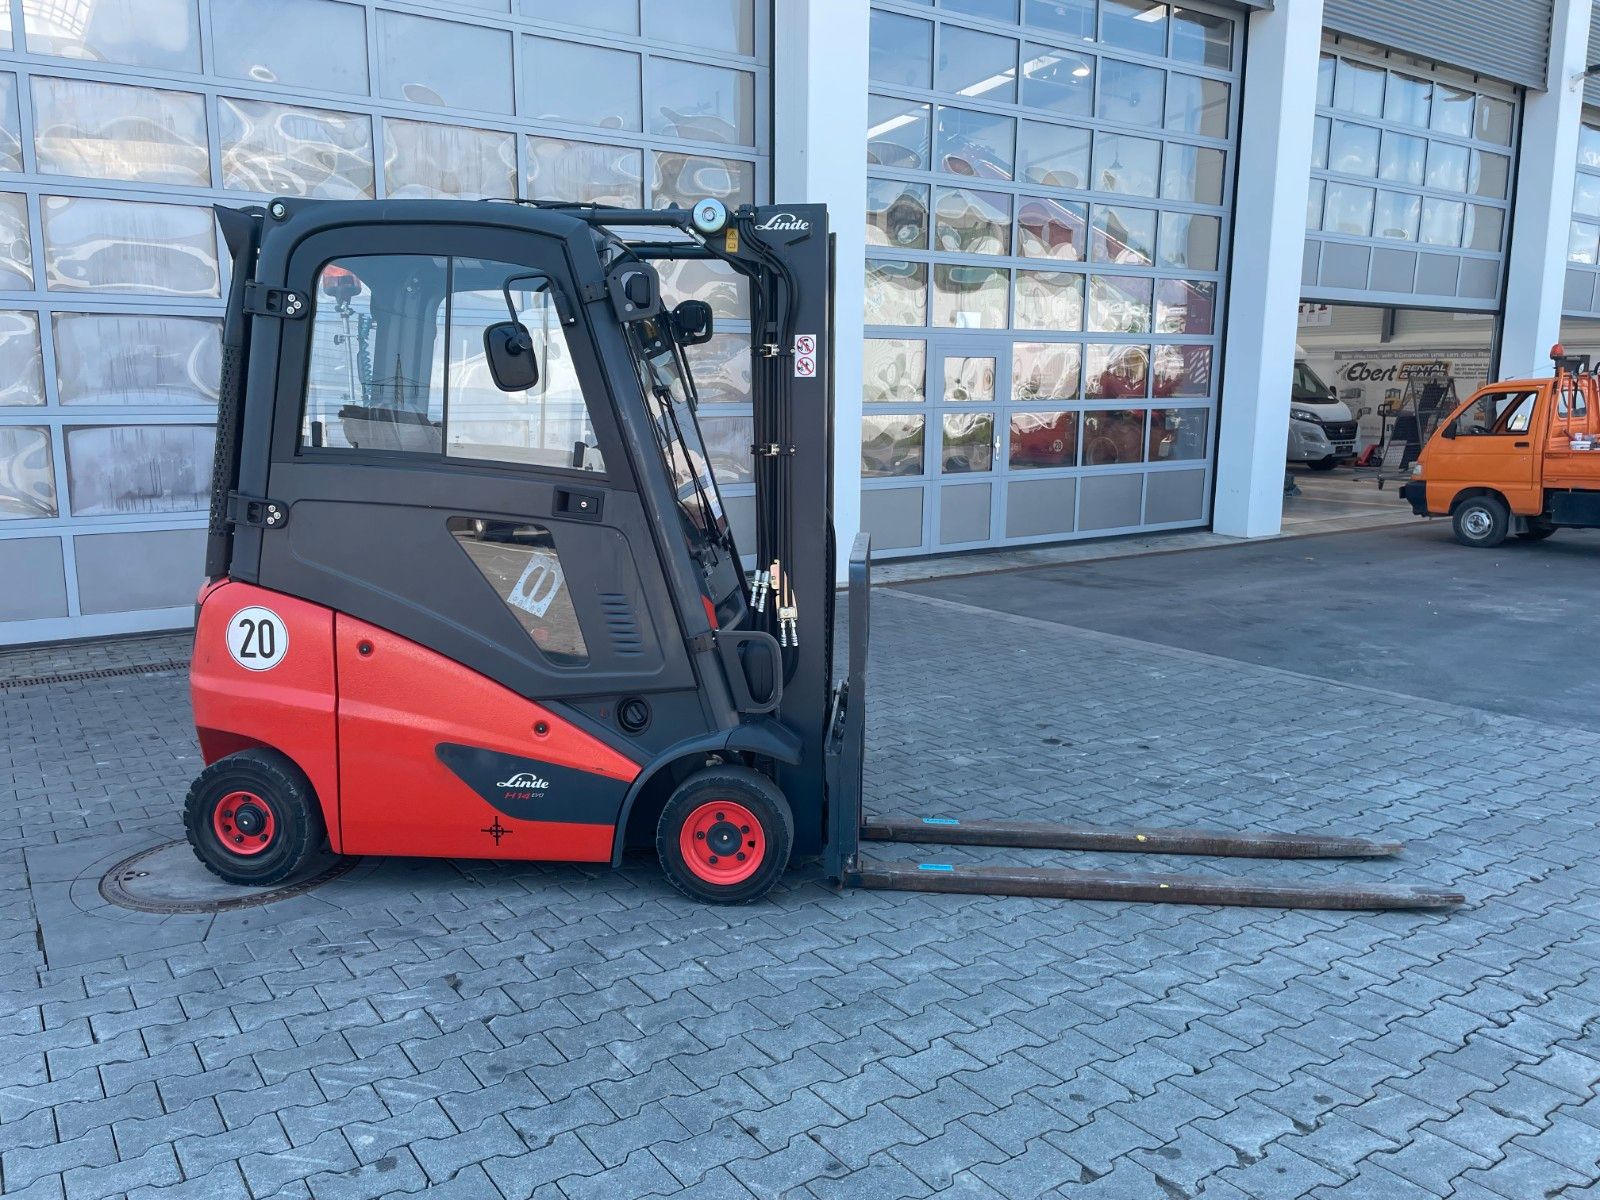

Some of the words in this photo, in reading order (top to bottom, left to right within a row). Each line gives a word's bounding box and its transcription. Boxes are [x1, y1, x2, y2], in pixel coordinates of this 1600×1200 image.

[754, 213, 810, 231] Linde
[1346, 362, 1398, 381] Ebert
[1402, 364, 1447, 372] RENTAL
[239, 618, 275, 659] 20
[496, 772, 550, 789] Linde
